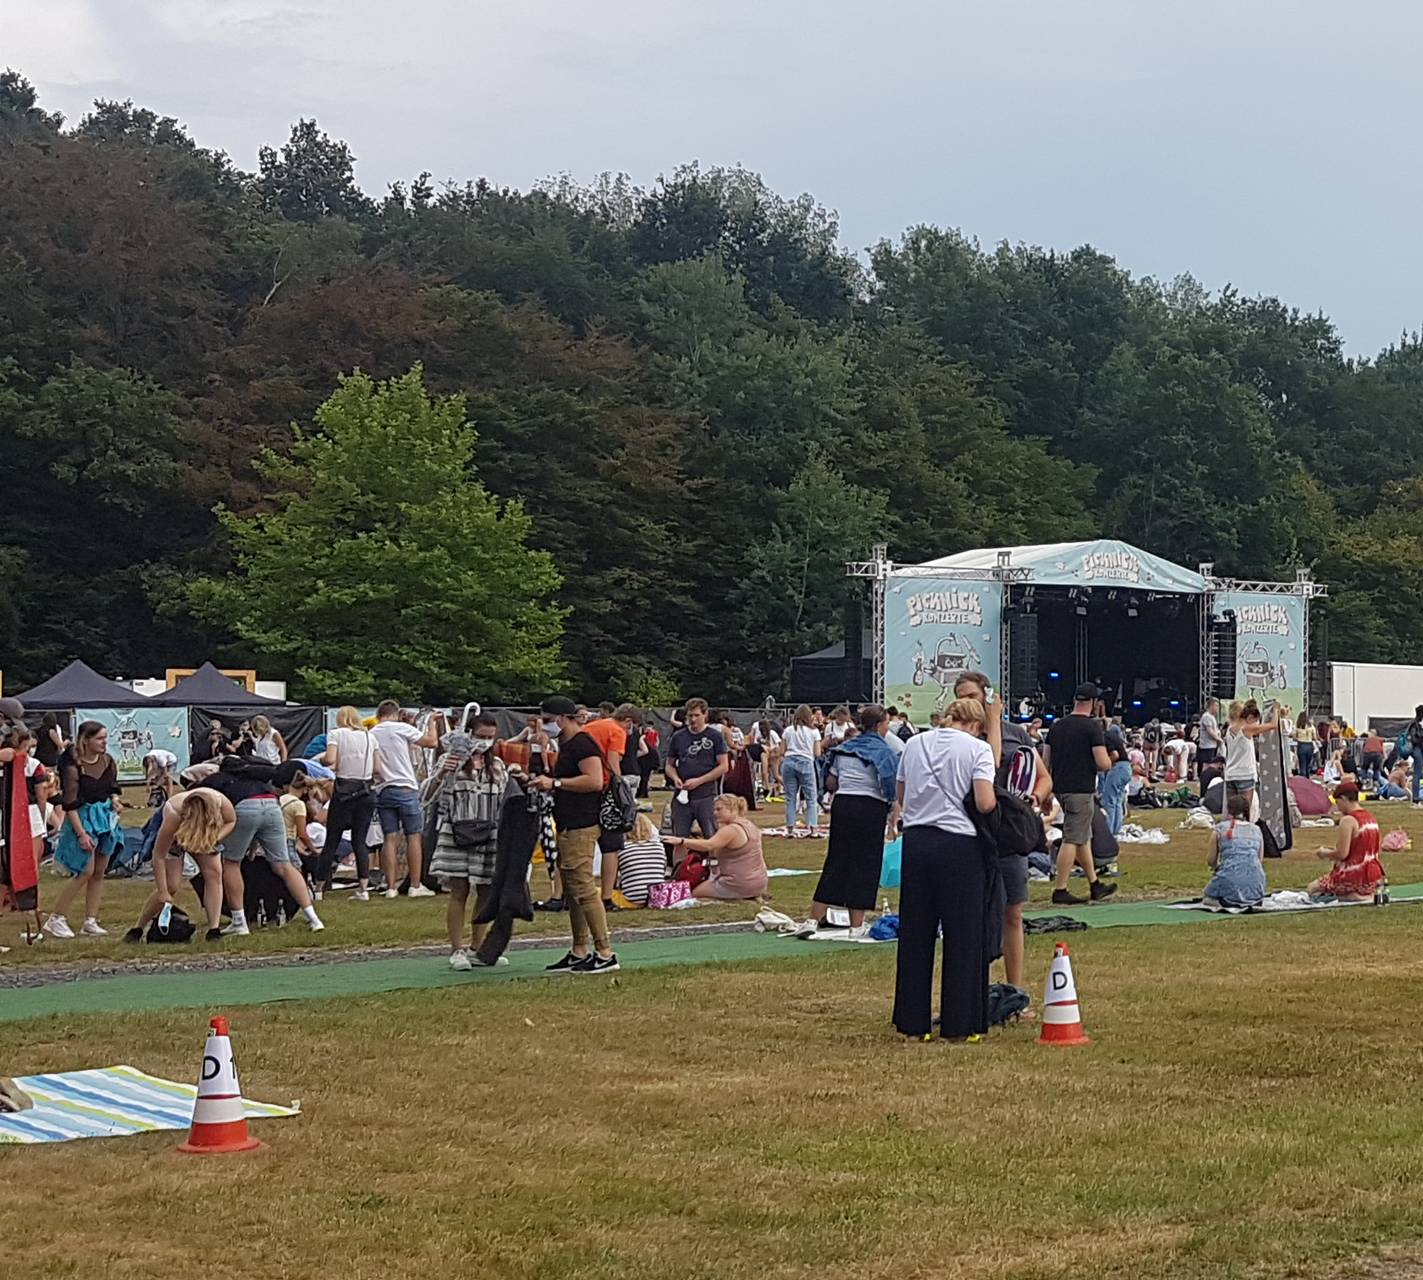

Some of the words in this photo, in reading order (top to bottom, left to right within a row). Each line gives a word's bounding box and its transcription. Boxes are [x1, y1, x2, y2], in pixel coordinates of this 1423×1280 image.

[1236, 603, 1288, 625] ICKNICK
[1053, 972, 1068, 990] D
[202, 1056, 220, 1080] D
